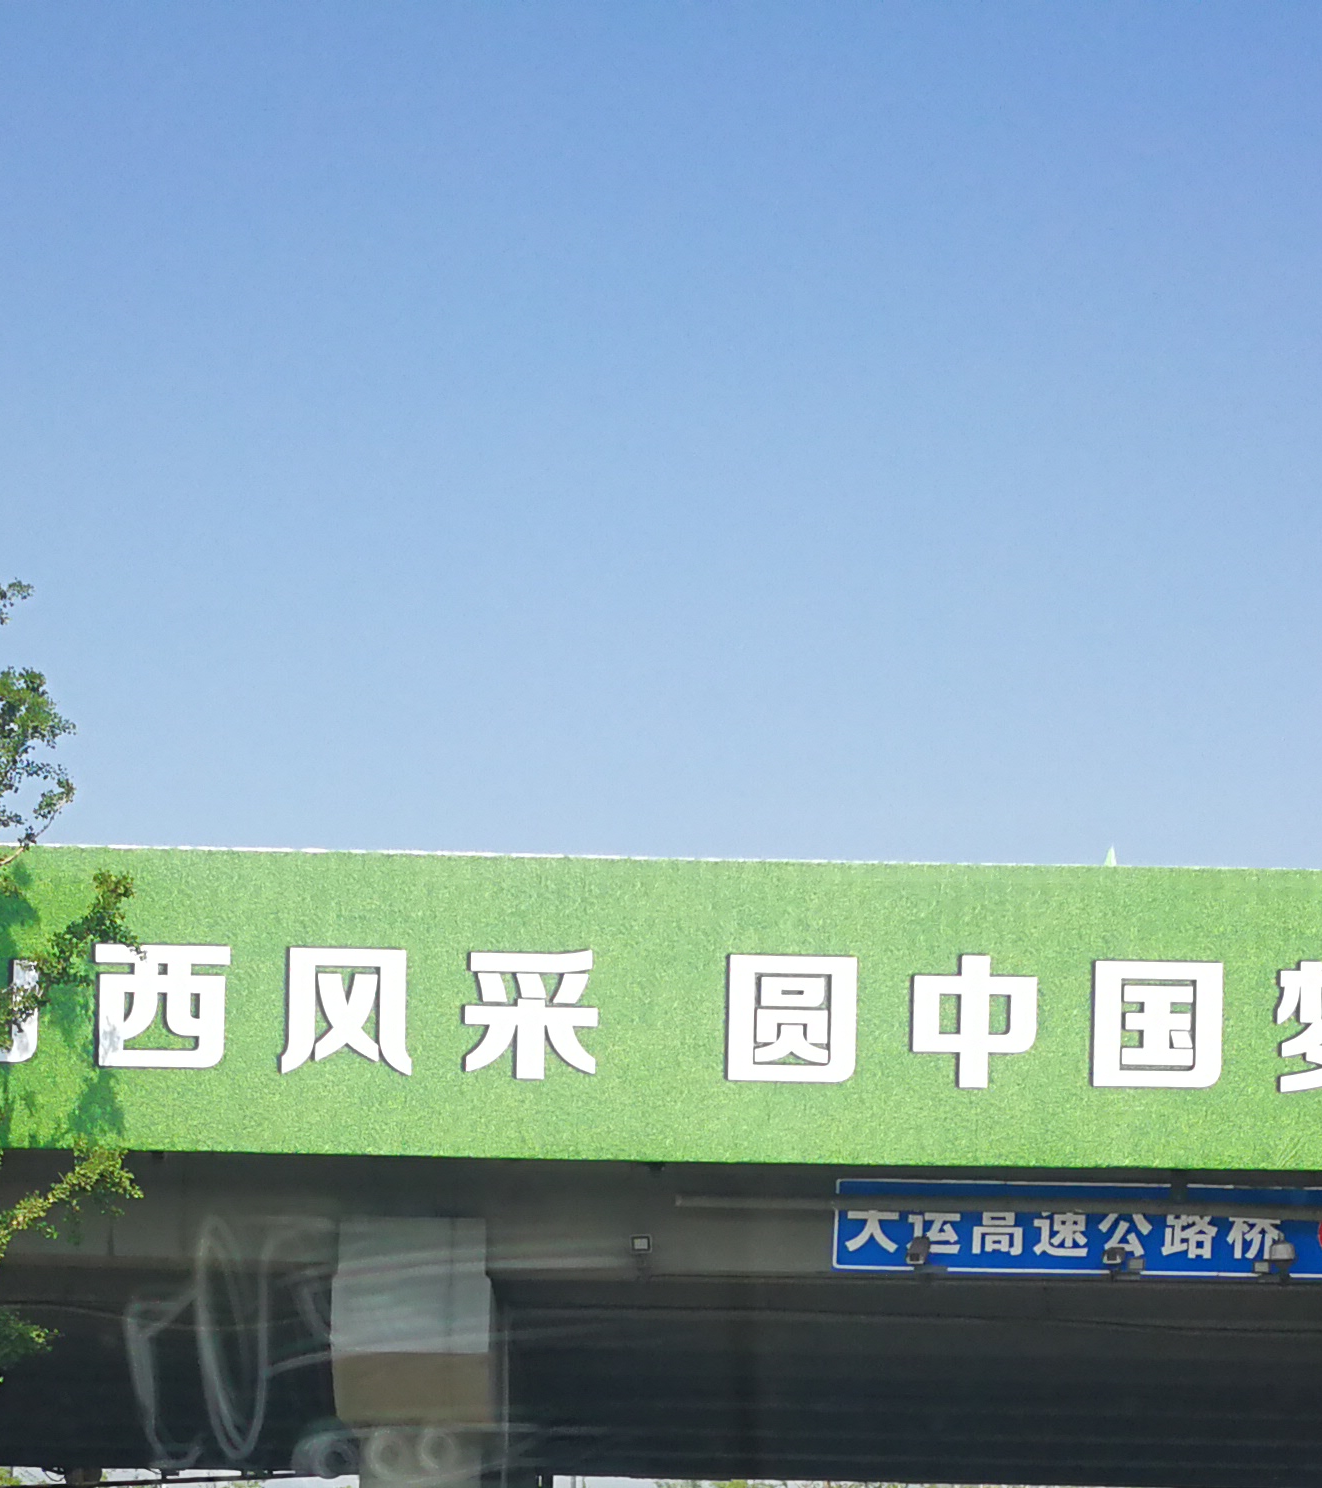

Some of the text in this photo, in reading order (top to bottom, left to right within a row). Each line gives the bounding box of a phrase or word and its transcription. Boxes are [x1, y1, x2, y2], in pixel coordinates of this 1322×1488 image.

[844, 1209, 1283, 1260] 大运高速公路桥
